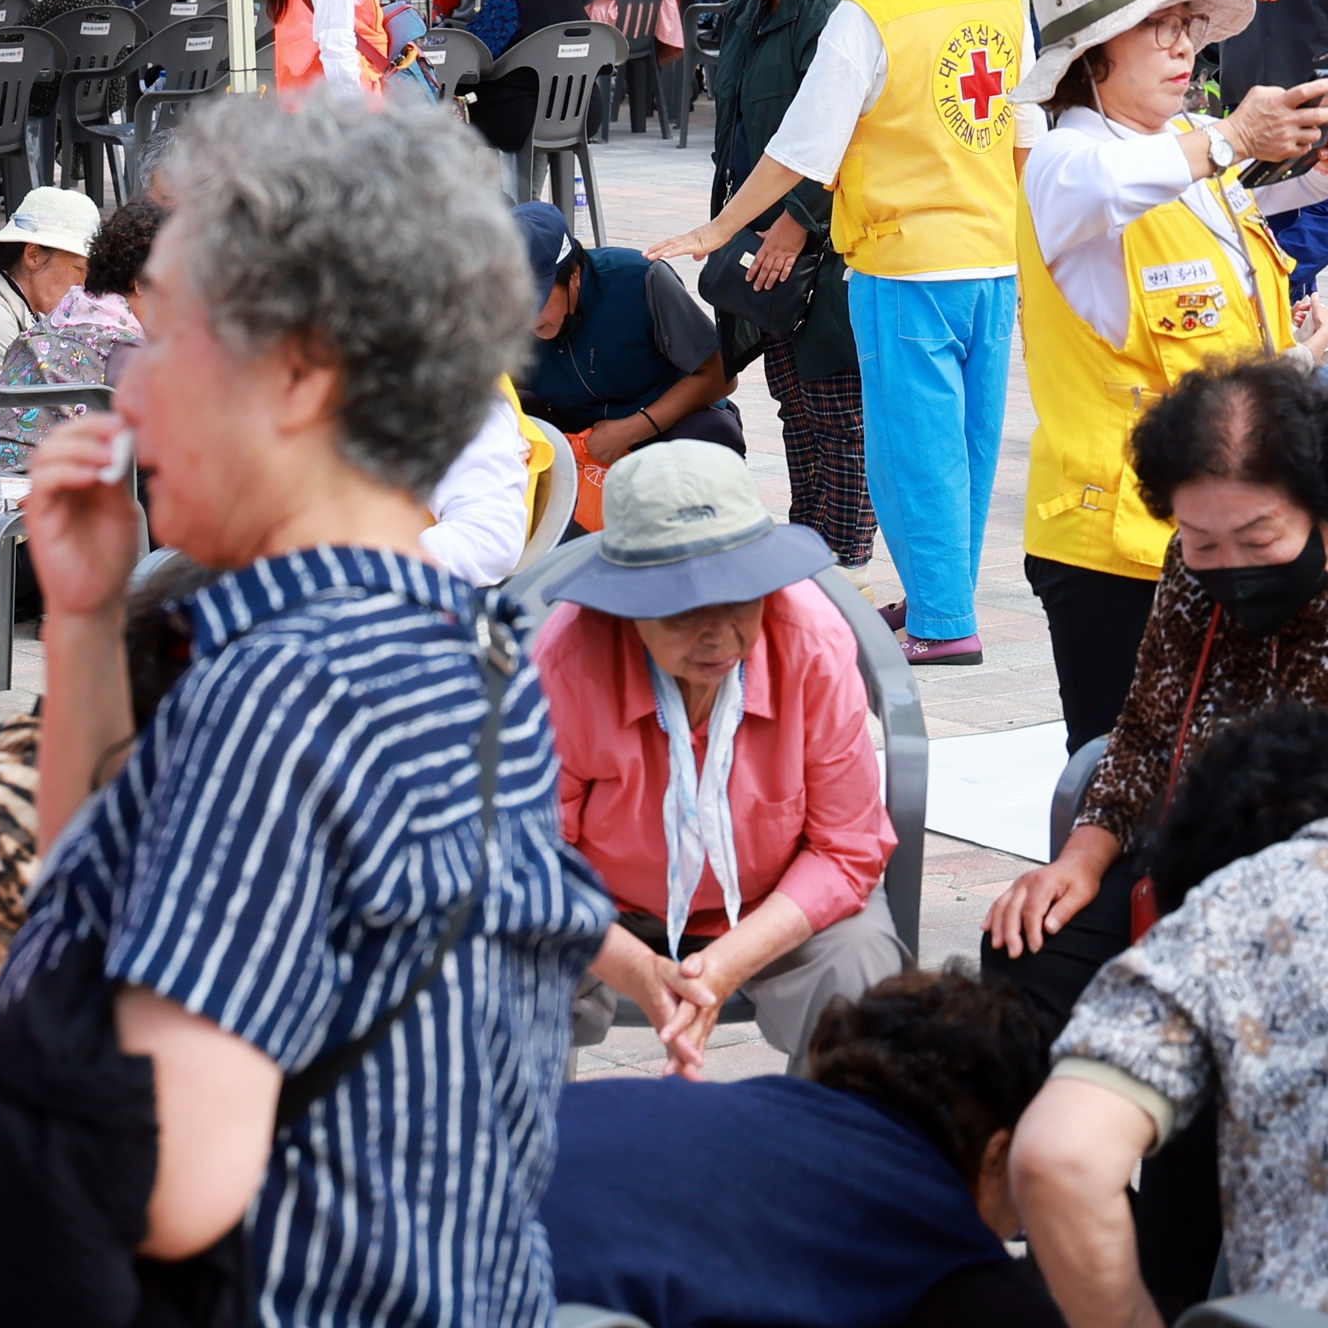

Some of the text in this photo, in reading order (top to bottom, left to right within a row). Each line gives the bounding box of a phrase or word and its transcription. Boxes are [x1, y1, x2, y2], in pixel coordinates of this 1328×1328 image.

[938, 23, 1015, 79] 대한적십자사
[939, 94, 976, 146] KOREAN
[976, 127, 991, 149] RED
